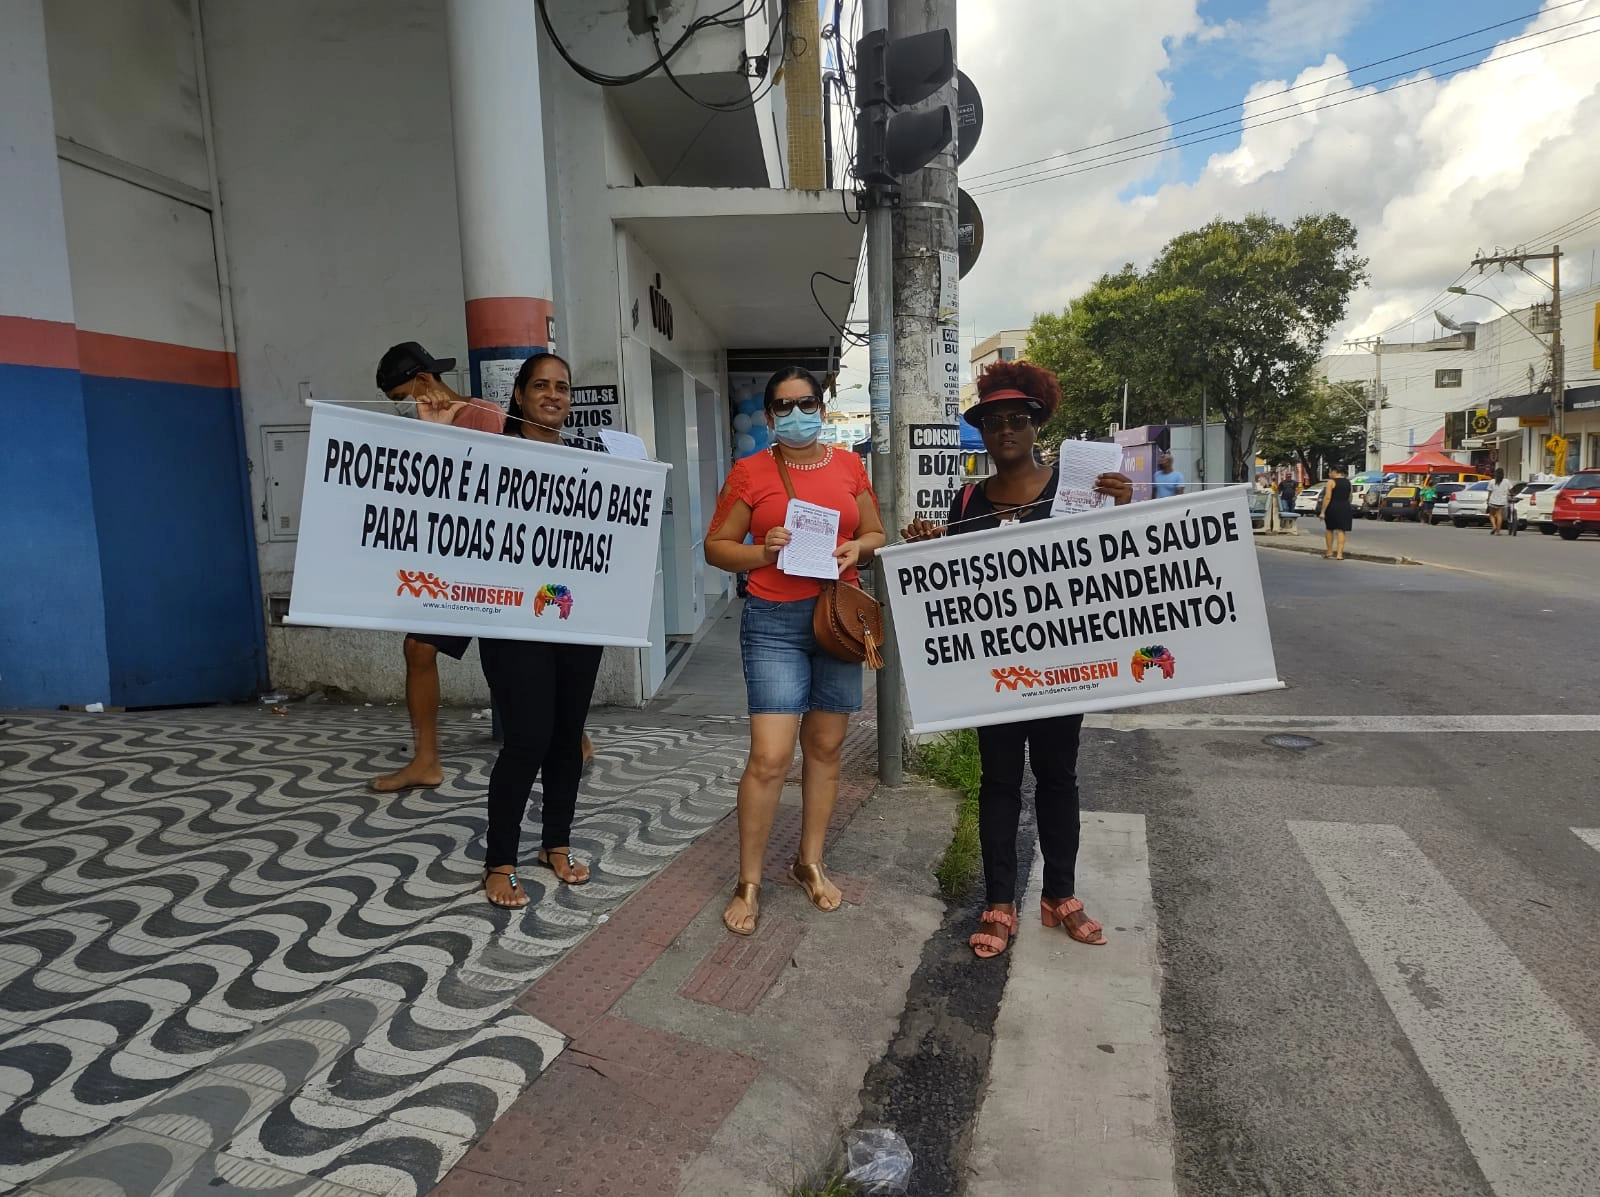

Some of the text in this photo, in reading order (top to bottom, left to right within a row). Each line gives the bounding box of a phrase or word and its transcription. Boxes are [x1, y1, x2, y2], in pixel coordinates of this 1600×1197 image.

[324, 439, 652, 527] PROFESSOR É A PROFISSÃO BASE
[948, 477, 954, 488] &
[361, 504, 613, 574] PARA TODAS AS OUTRAS!
[897, 509, 1239, 596] PROFISSIONAIS DA SAÚDE
[451, 585, 524, 607] SINDSERV
[925, 557, 1222, 629] HERÓIS DA PANDEMIA,
[924, 592, 1237, 666] SEM RECONHECIMENTO!
[1044, 662, 1119, 686] SINDSERV
